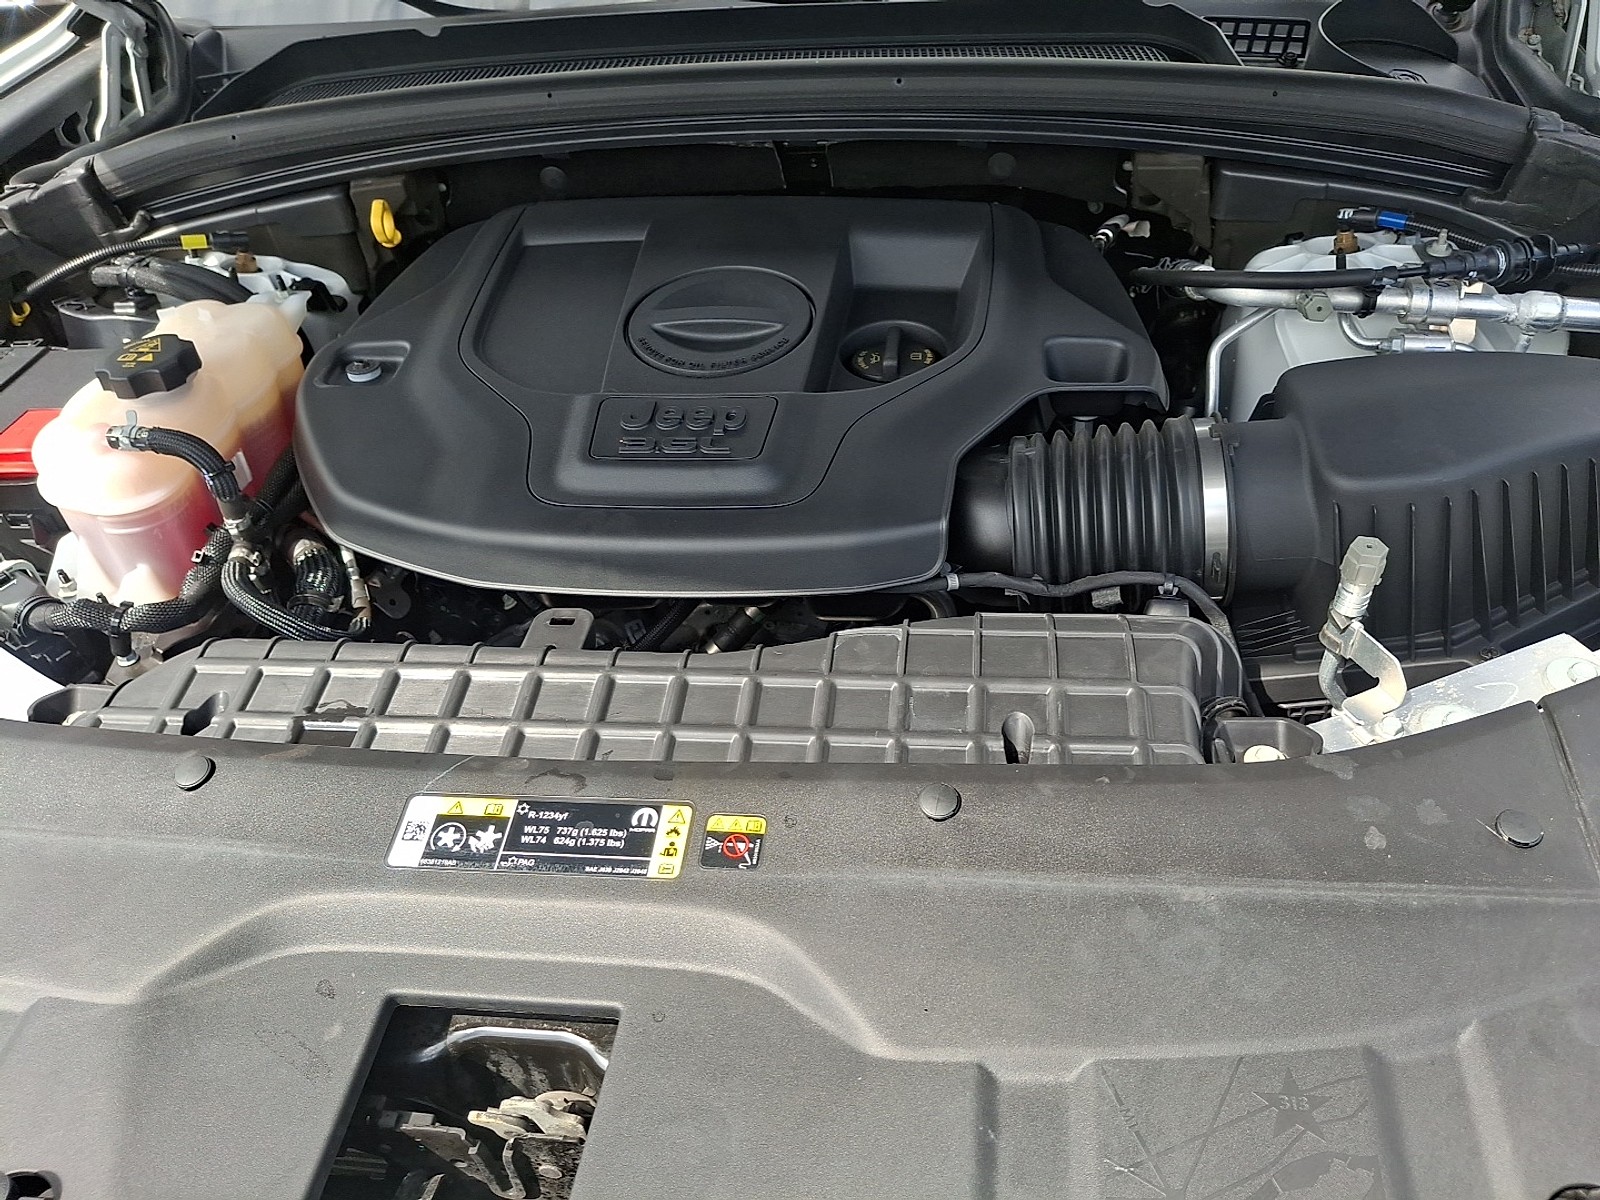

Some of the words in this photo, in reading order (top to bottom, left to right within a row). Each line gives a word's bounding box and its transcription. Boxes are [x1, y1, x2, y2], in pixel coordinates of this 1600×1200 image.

[620, 401, 748, 436] Jeep
[618, 436, 732, 455] 3.6L
[528, 810, 569, 822] R-1234yf
[523, 825, 550, 835] WL75
[556, 826, 579, 836] 737g
[579, 827, 608, 838] (1.625
[608, 829, 628, 839] lbs)
[521, 835, 547, 845] WL74
[553, 837, 576, 847] 624g
[576, 837, 606, 848] (1.375
[606, 838, 626, 849] lbs)
